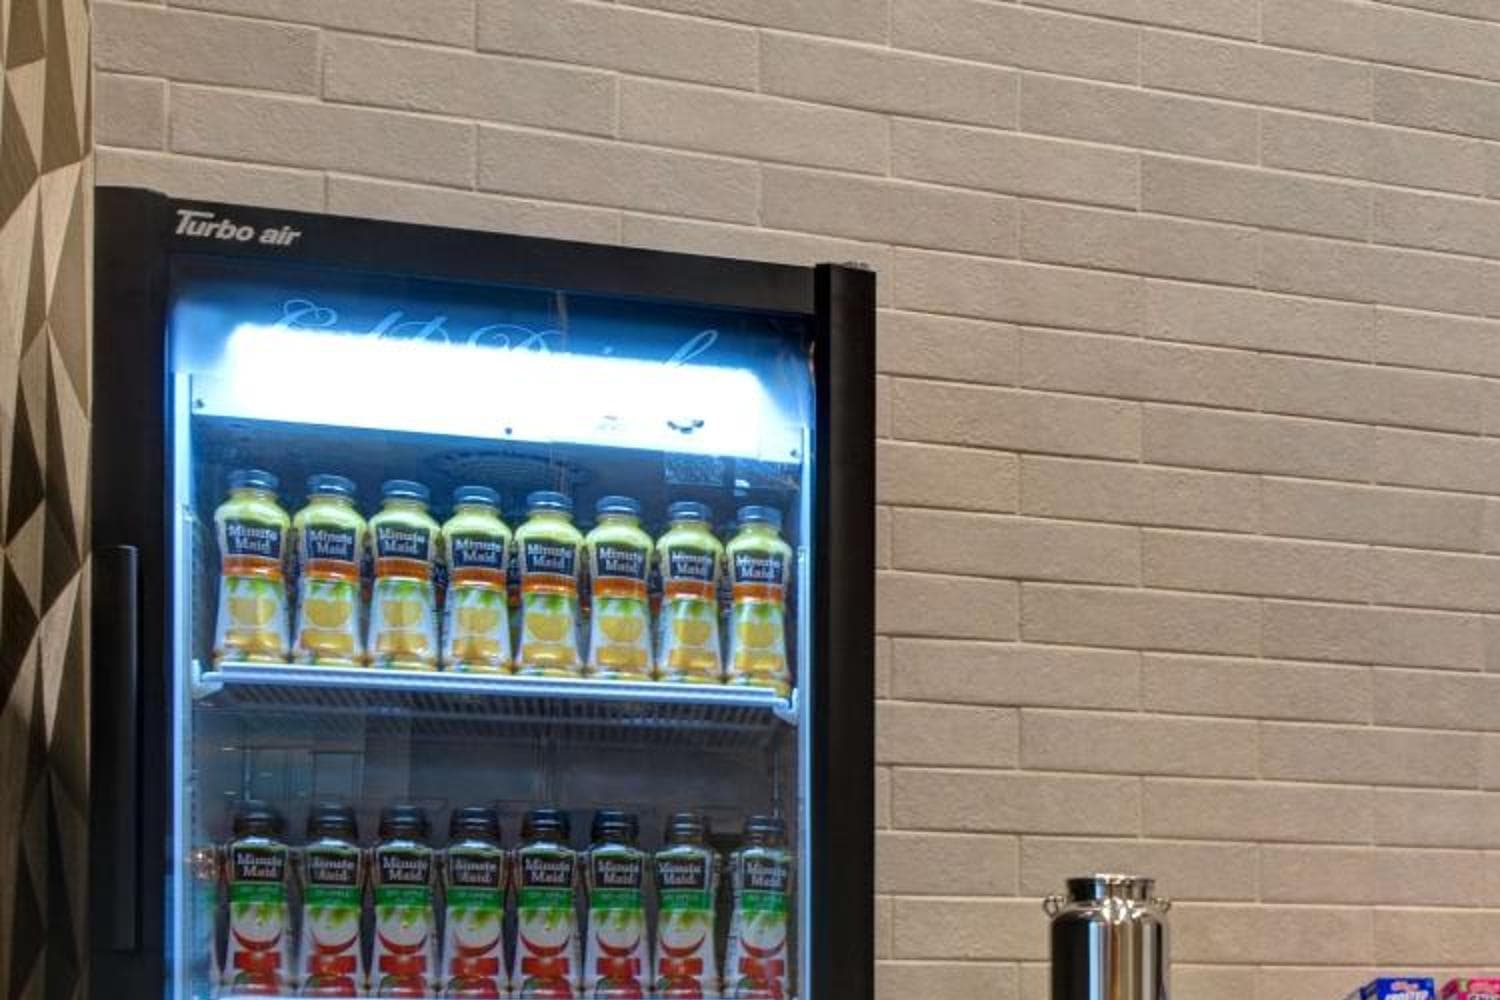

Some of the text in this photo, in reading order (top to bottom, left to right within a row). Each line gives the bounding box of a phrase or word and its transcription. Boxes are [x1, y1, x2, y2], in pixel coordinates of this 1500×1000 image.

[176, 209, 302, 246] Turbo air
[228, 525, 278, 541] Minute
[309, 531, 354, 546] Minute
[379, 527, 426, 543] Minute
[235, 538, 271, 553] Maid
[455, 538, 502, 552] Minute
[527, 543, 573, 558] Minute
[462, 549, 496, 563] Maid
[599, 546, 644, 562] Minute
[736, 554, 781, 568] Minute
[533, 555, 565, 570] Maid
[605, 559, 638, 574] Maid
[237, 852, 282, 868] Minute
[382, 856, 428, 871] Minute
[525, 858, 571, 873] Minute
[597, 859, 640, 873] Minute
[243, 865, 277, 878] Maid
[531, 870, 566, 884] Maid
[603, 871, 637, 885] Maid
